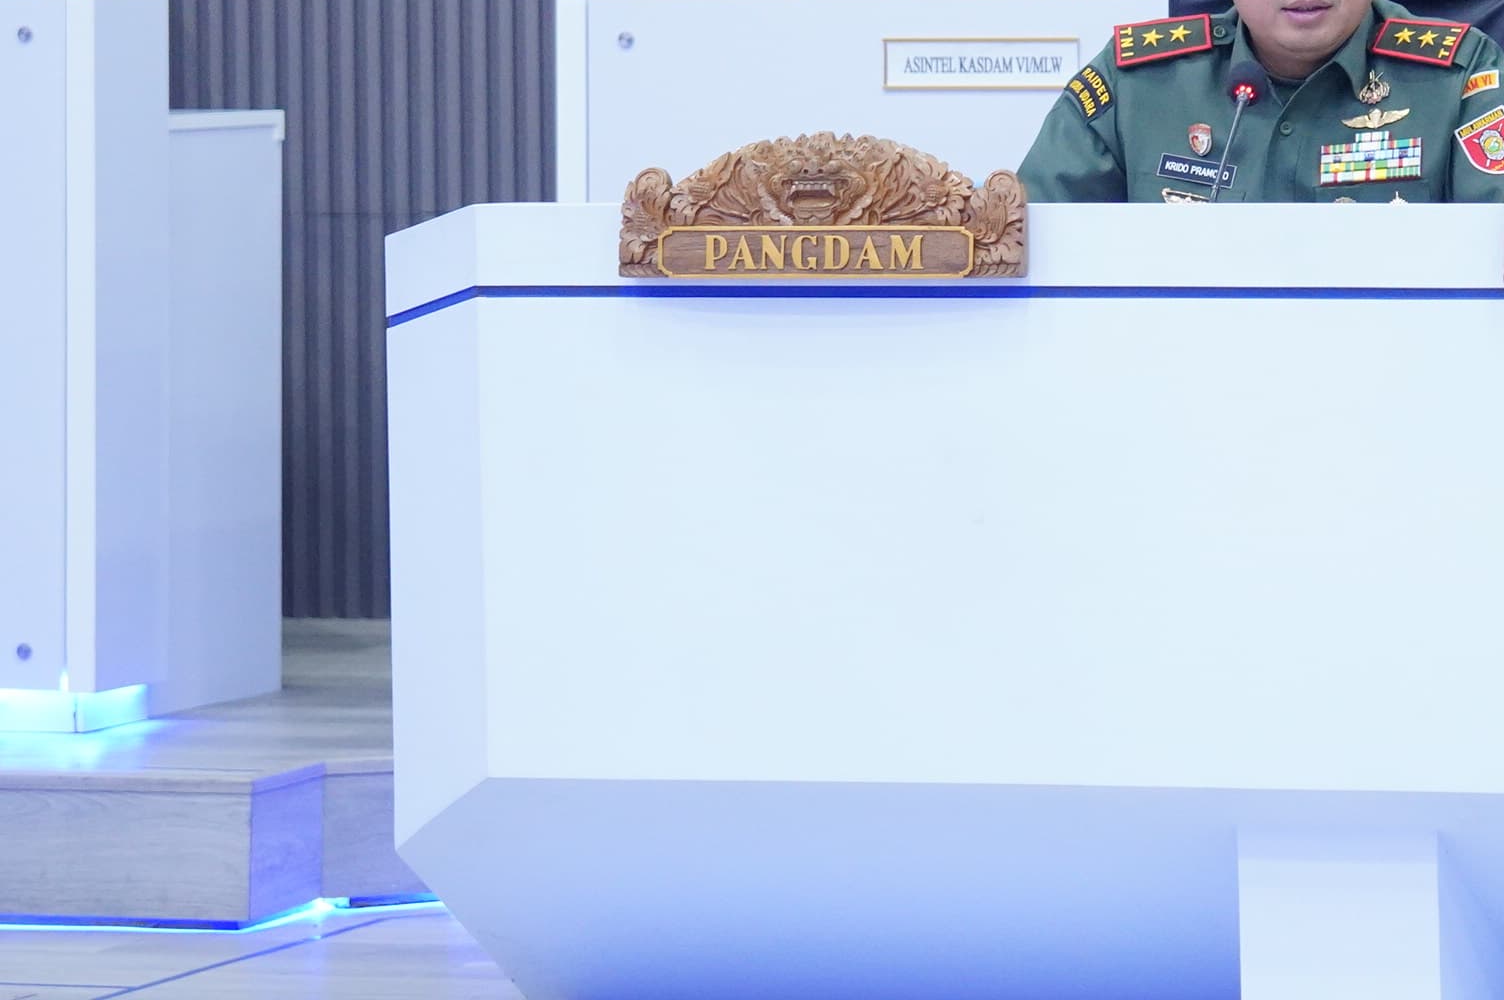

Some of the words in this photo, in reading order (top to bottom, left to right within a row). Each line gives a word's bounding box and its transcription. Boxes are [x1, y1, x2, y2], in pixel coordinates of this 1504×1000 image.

[1119, 26, 1134, 58] TNI
[1437, 27, 1462, 59] TNI
[903, 55, 957, 74] ASINTEL
[959, 55, 1013, 74] KASDAM
[1016, 55, 1063, 74] VI/MLW
[1081, 67, 1111, 105] RAIDER
[1164, 160, 1190, 174] KRIDO
[704, 233, 924, 271] PANGDAM
